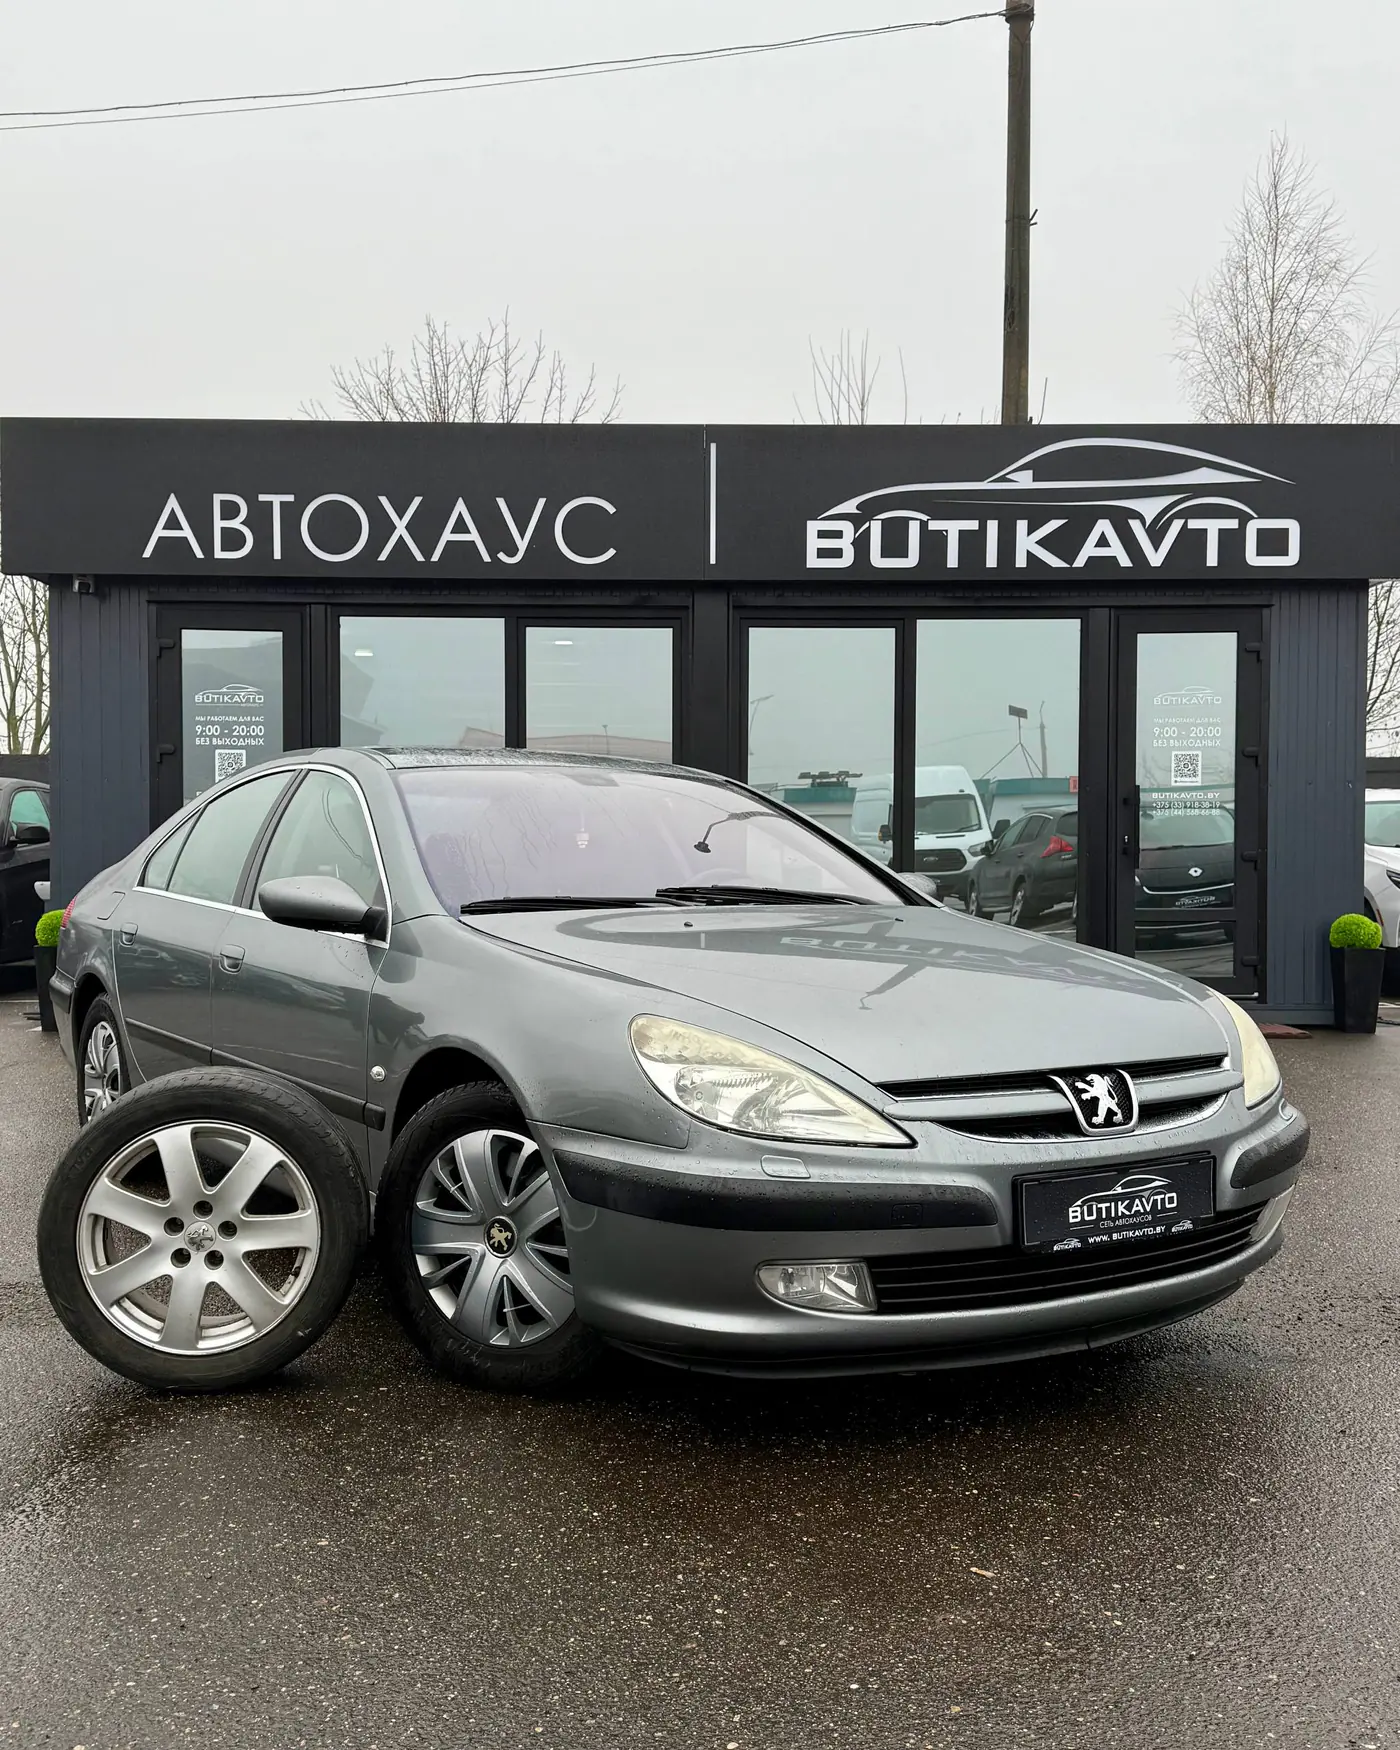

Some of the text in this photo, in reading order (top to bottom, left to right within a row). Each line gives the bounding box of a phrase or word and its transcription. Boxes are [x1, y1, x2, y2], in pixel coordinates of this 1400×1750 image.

[142, 492, 617, 565] АВТОХАУС
[805, 518, 1301, 569] BUTIKAVTO
[195, 694, 264, 703] BUTIKAVTO
[1153, 696, 1222, 705] BUTIKAVTO
[195, 724, 221, 736] 9:00
[232, 724, 265, 736] 20:00
[1153, 726, 1178, 737] 9:00
[1190, 726, 1222, 737] 20:00
[195, 737, 265, 747] БЕЗ ВЫХОДНЫХ
[1153, 739, 1221, 748] БЕЗ ВЫХОДНЫХ
[1152, 801, 1169, 809] +375
[1170, 801, 1185, 810] (33)
[1068, 1192, 1178, 1224] BUTIKAVTO
[1099, 1214, 1152, 1229] СЕТЬ АВТОХАУСОВ
